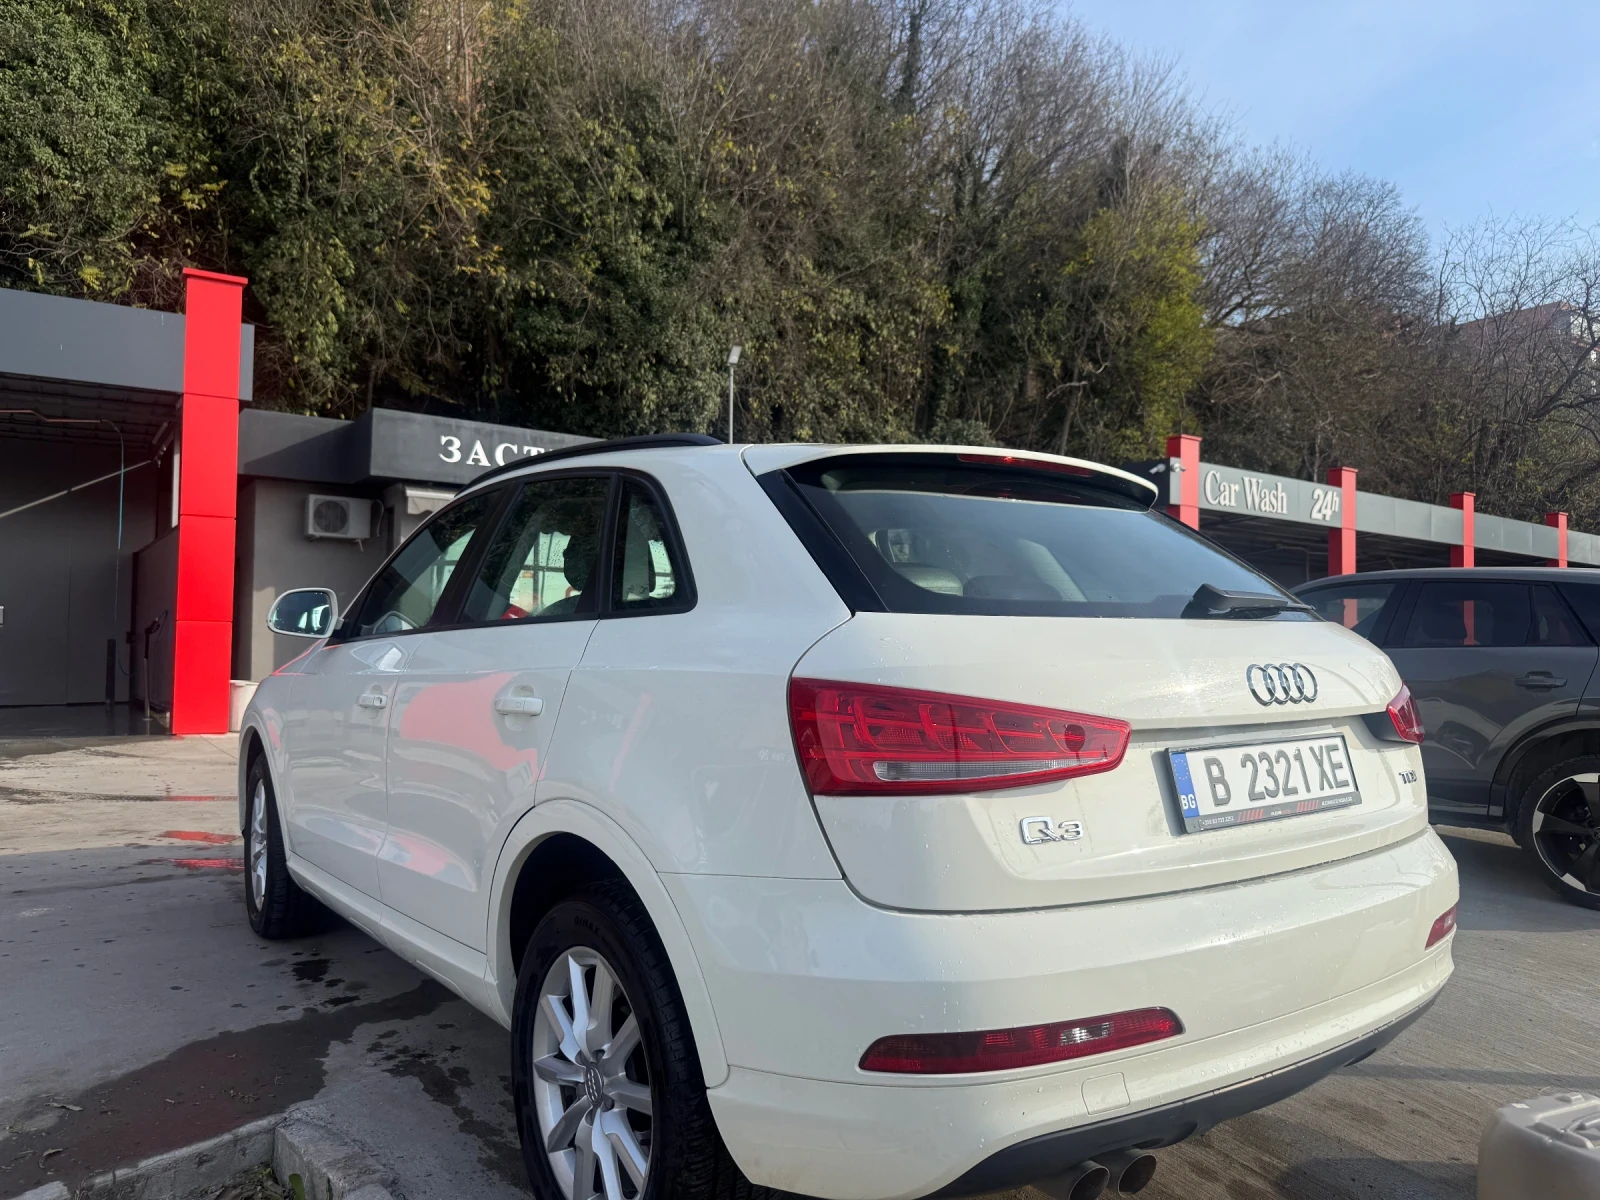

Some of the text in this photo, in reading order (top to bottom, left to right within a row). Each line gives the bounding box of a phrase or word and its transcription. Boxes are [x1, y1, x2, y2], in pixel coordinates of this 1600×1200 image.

[438, 435, 553, 467] ЗАС
[1204, 469, 1340, 521] Car Wash 24h
[1203, 744, 1350, 807] B 2321 XE
[1180, 794, 1197, 810] BG
[1019, 816, 1084, 845] Q3
